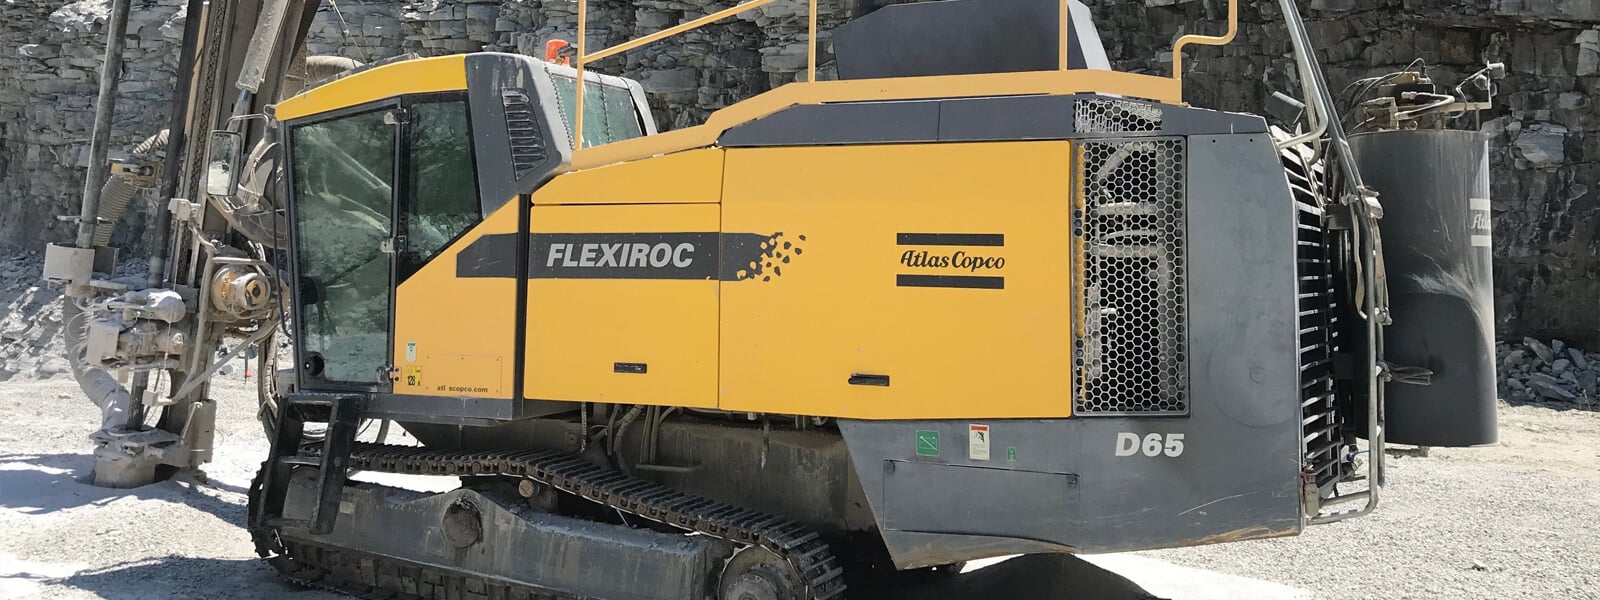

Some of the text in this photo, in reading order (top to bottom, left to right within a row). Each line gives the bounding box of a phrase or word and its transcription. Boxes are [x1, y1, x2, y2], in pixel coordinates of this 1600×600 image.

[546, 242, 695, 268] FLEXIROC
[900, 249, 1005, 273] Atlas Copco
[1115, 432, 1185, 458] D65
